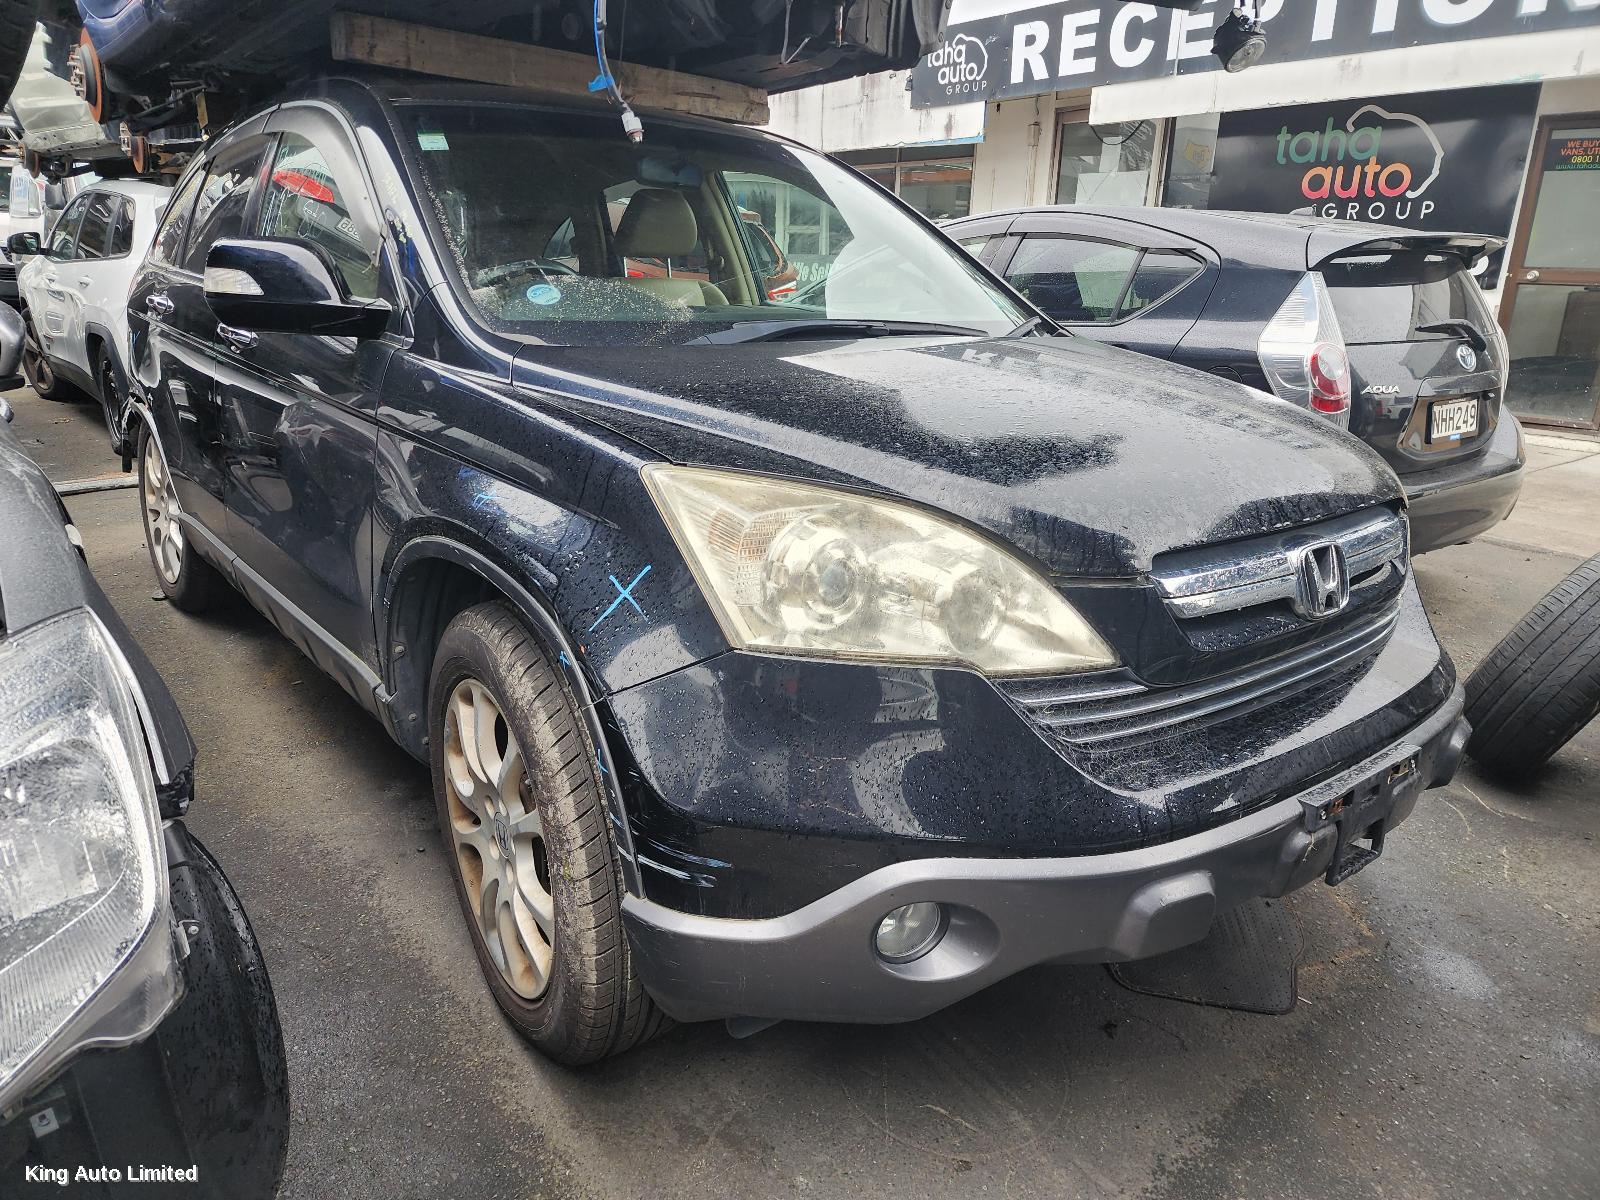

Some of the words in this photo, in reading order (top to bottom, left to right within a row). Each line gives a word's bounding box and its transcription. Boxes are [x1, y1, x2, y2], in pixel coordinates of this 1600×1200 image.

[1010, 0, 1600, 84] RECETI
[938, 61, 978, 84] auto
[946, 81, 987, 95] GROUP
[1276, 117, 1382, 164] taha
[1567, 140, 1582, 148] WE
[1583, 139, 1600, 148] BUY
[1571, 155, 1593, 164] 0800
[1301, 156, 1412, 199] auto
[1321, 201, 1435, 220] GROUP
[1361, 384, 1400, 396] AQUA
[1433, 404, 1477, 435] NHH249
